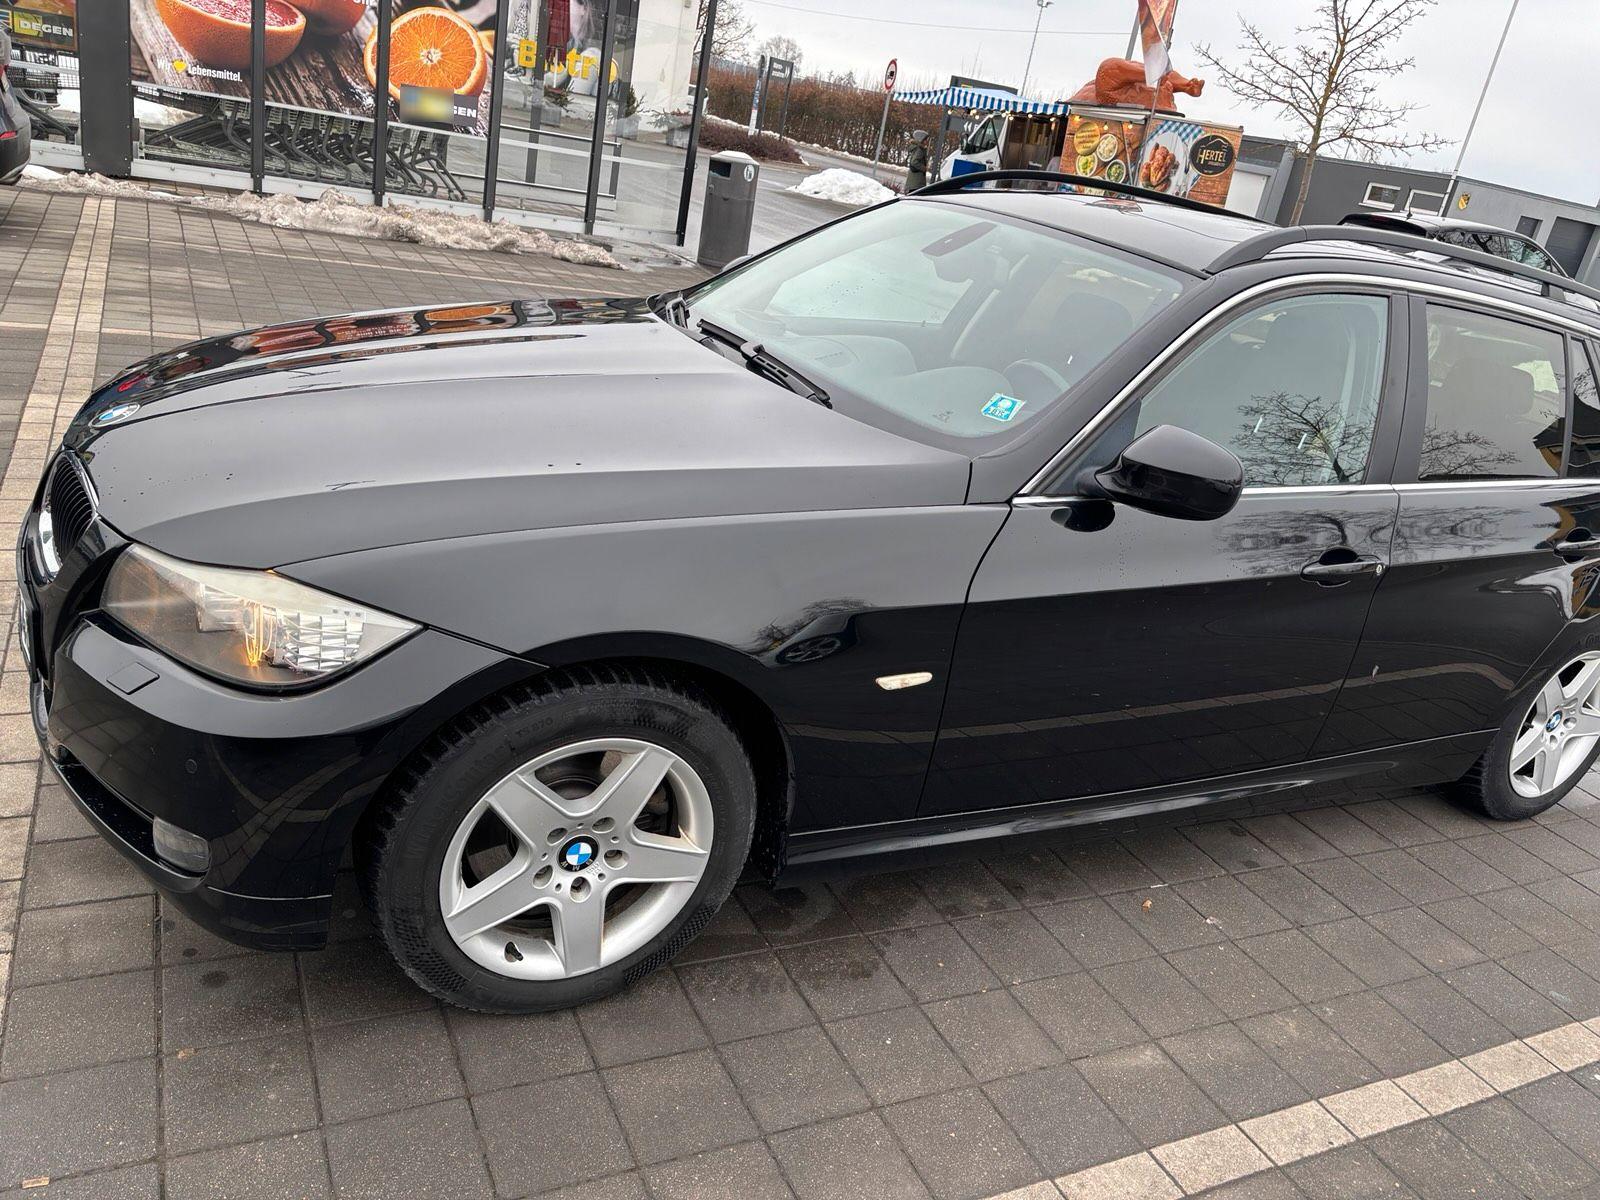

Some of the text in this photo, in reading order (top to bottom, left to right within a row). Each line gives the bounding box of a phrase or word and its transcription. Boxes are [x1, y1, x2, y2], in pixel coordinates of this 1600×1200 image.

[20, 20, 74, 37] DEGEN
[156, 58, 243, 82] Wir Lebensmittel.
[1196, 149, 1227, 164] HERTEL
